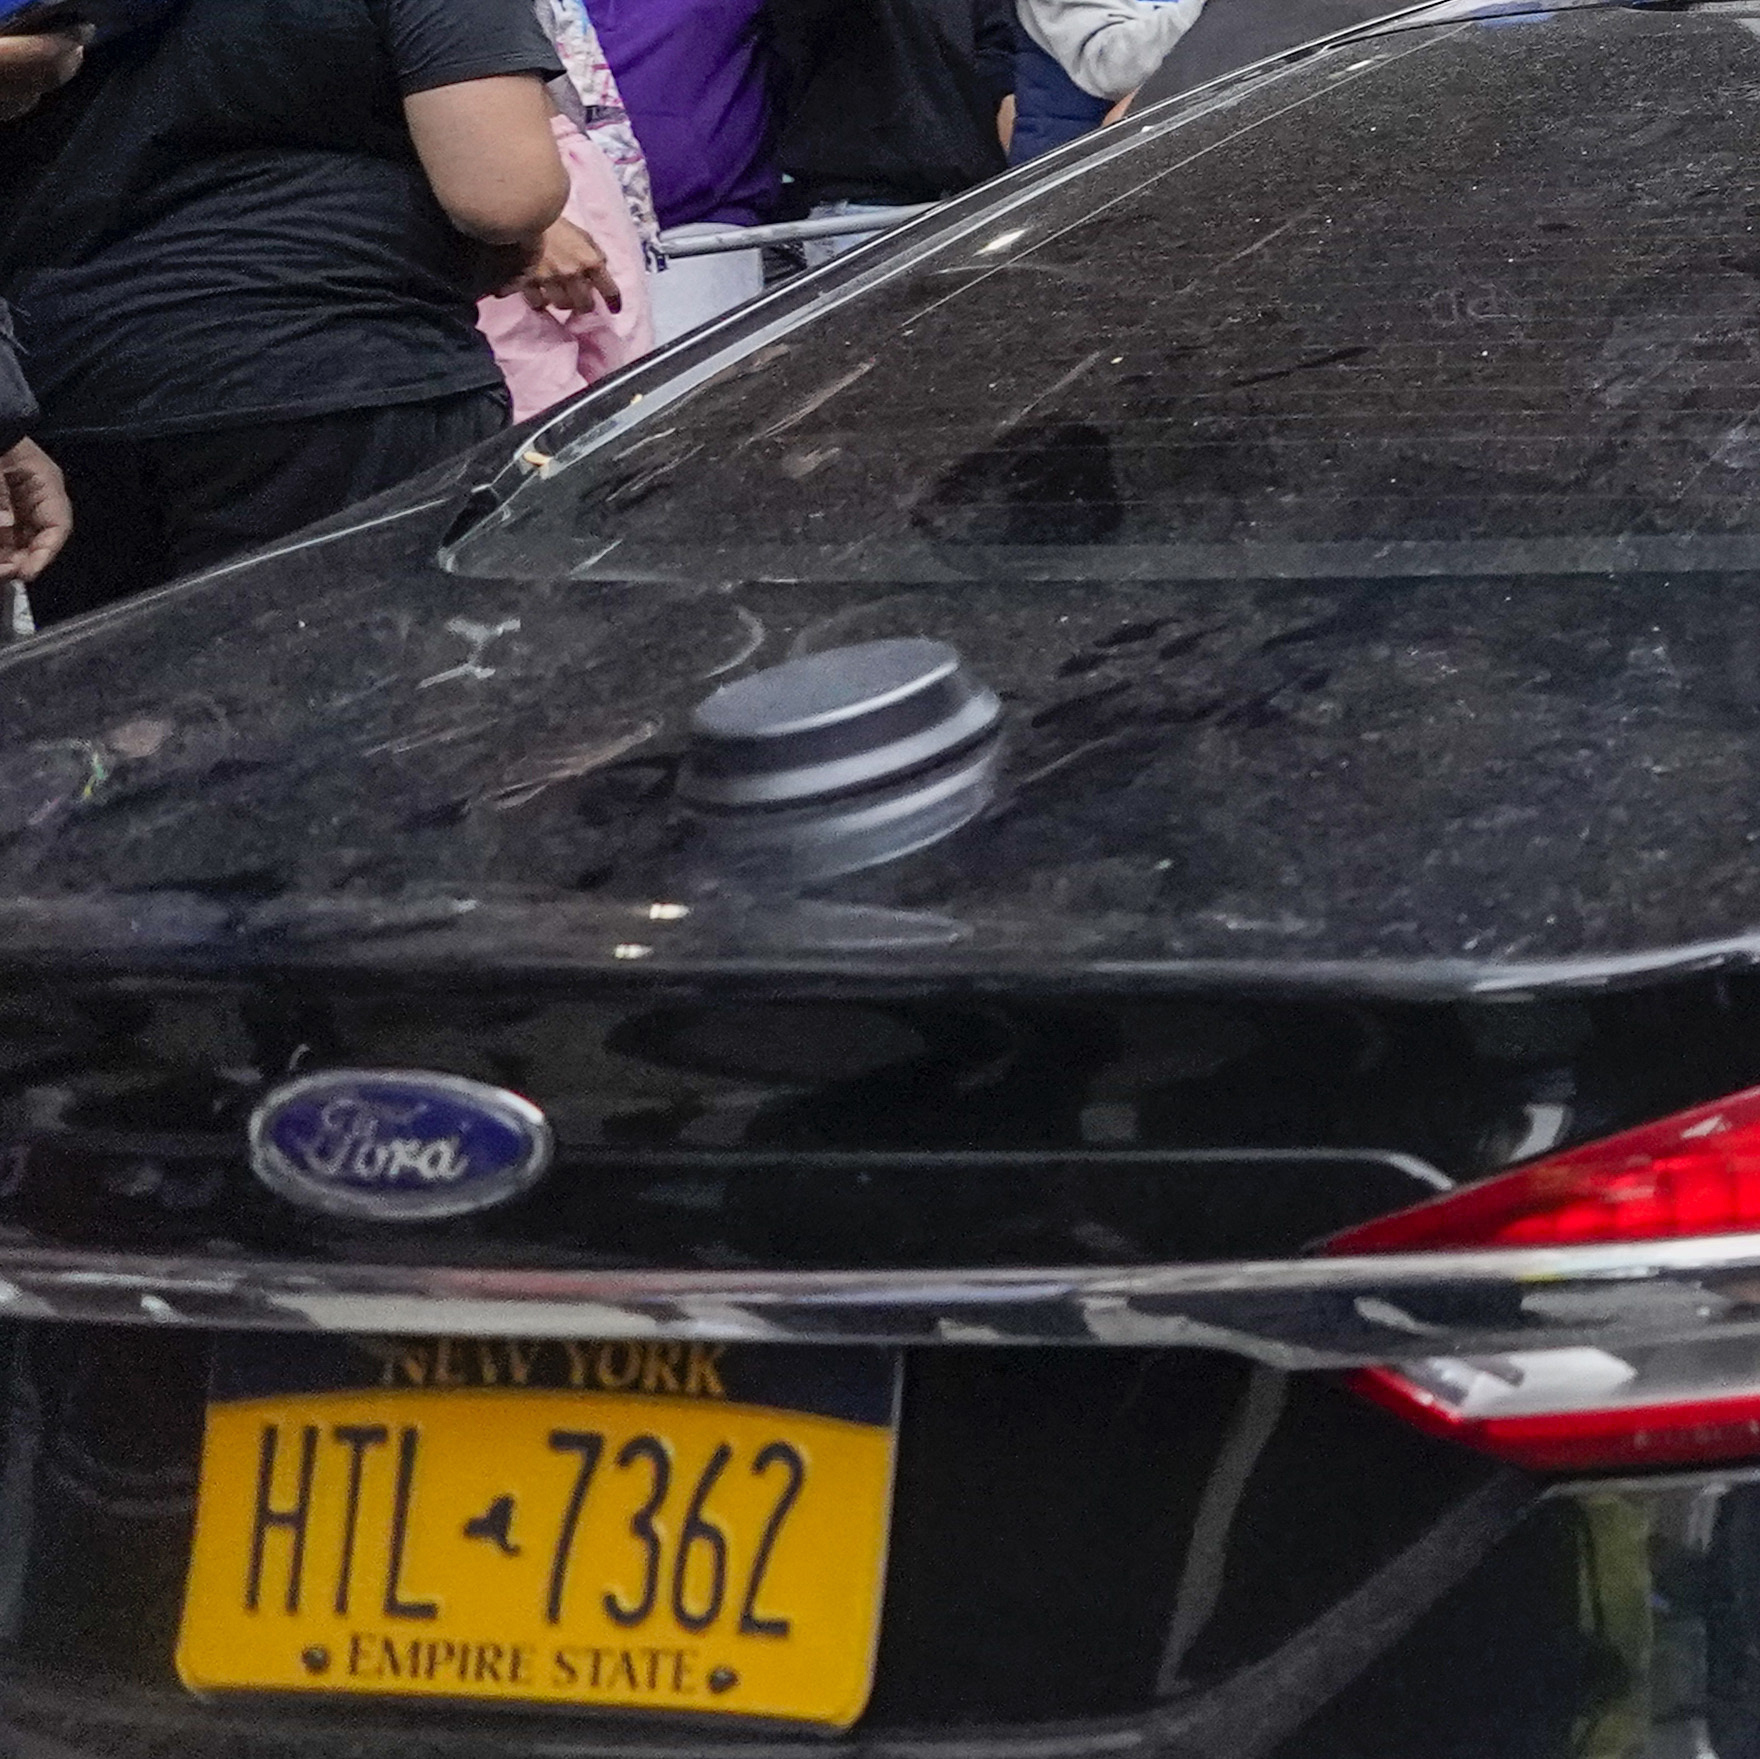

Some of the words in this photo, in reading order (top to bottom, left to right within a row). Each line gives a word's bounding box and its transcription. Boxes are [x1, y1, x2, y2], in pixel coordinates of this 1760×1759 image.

[299, 1096, 472, 1181] Ford
[380, 1340, 539, 1390] NEW
[564, 1340, 729, 1398] YORK
[243, 1422, 440, 1622] HTL
[546, 1428, 808, 1638] 7362
[345, 1634, 534, 1683] EMPIRE
[551, 1644, 698, 1695] STATE
